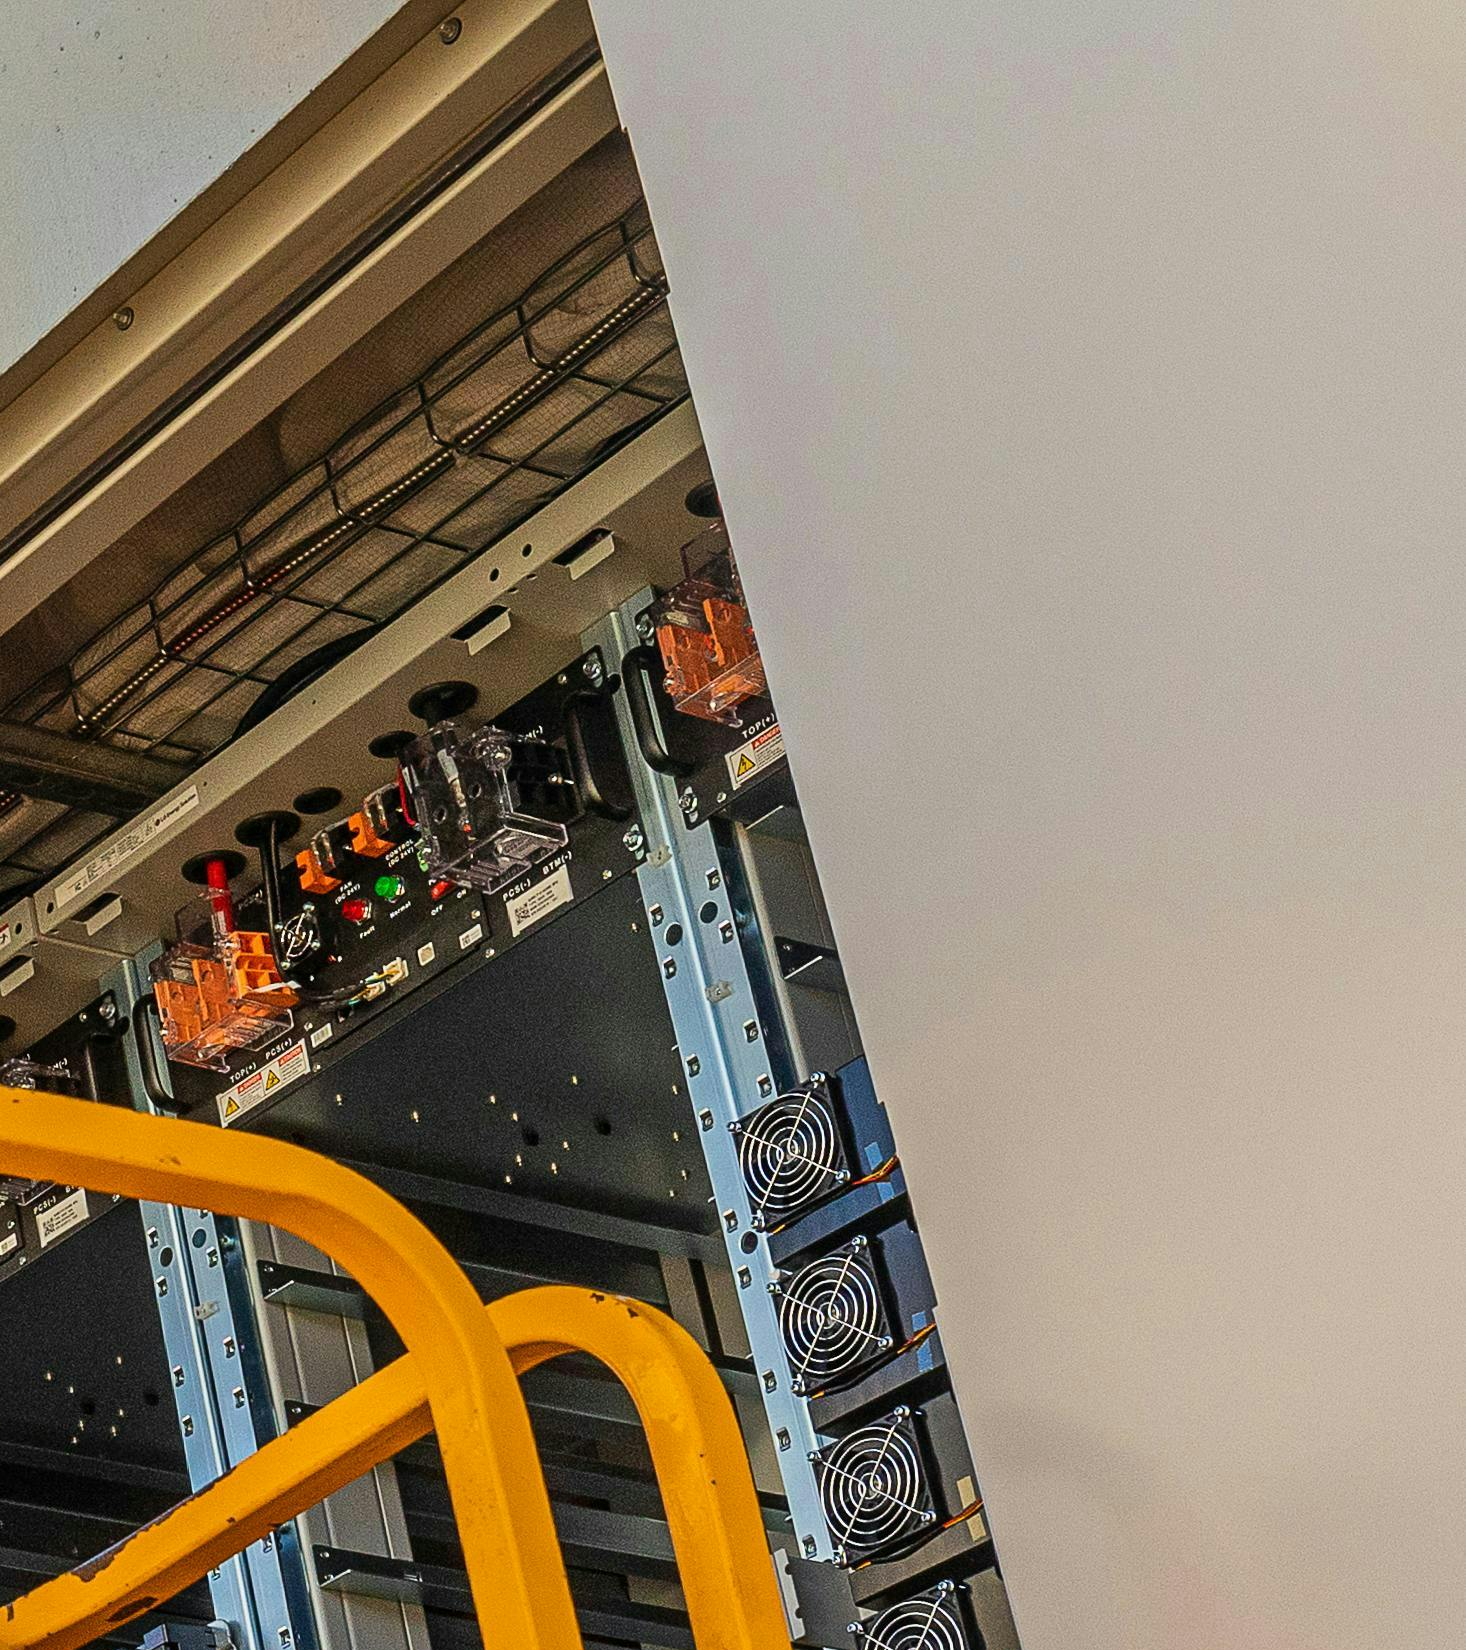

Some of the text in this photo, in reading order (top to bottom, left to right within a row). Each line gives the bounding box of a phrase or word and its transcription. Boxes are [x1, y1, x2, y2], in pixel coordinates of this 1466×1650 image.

[742, 713, 775, 739] TOP(+)
[502, 878, 531, 901] PCS(-)
[542, 850, 572, 875] BTM(-)
[229, 1038, 292, 1083] TOP(+) PCS(+)
